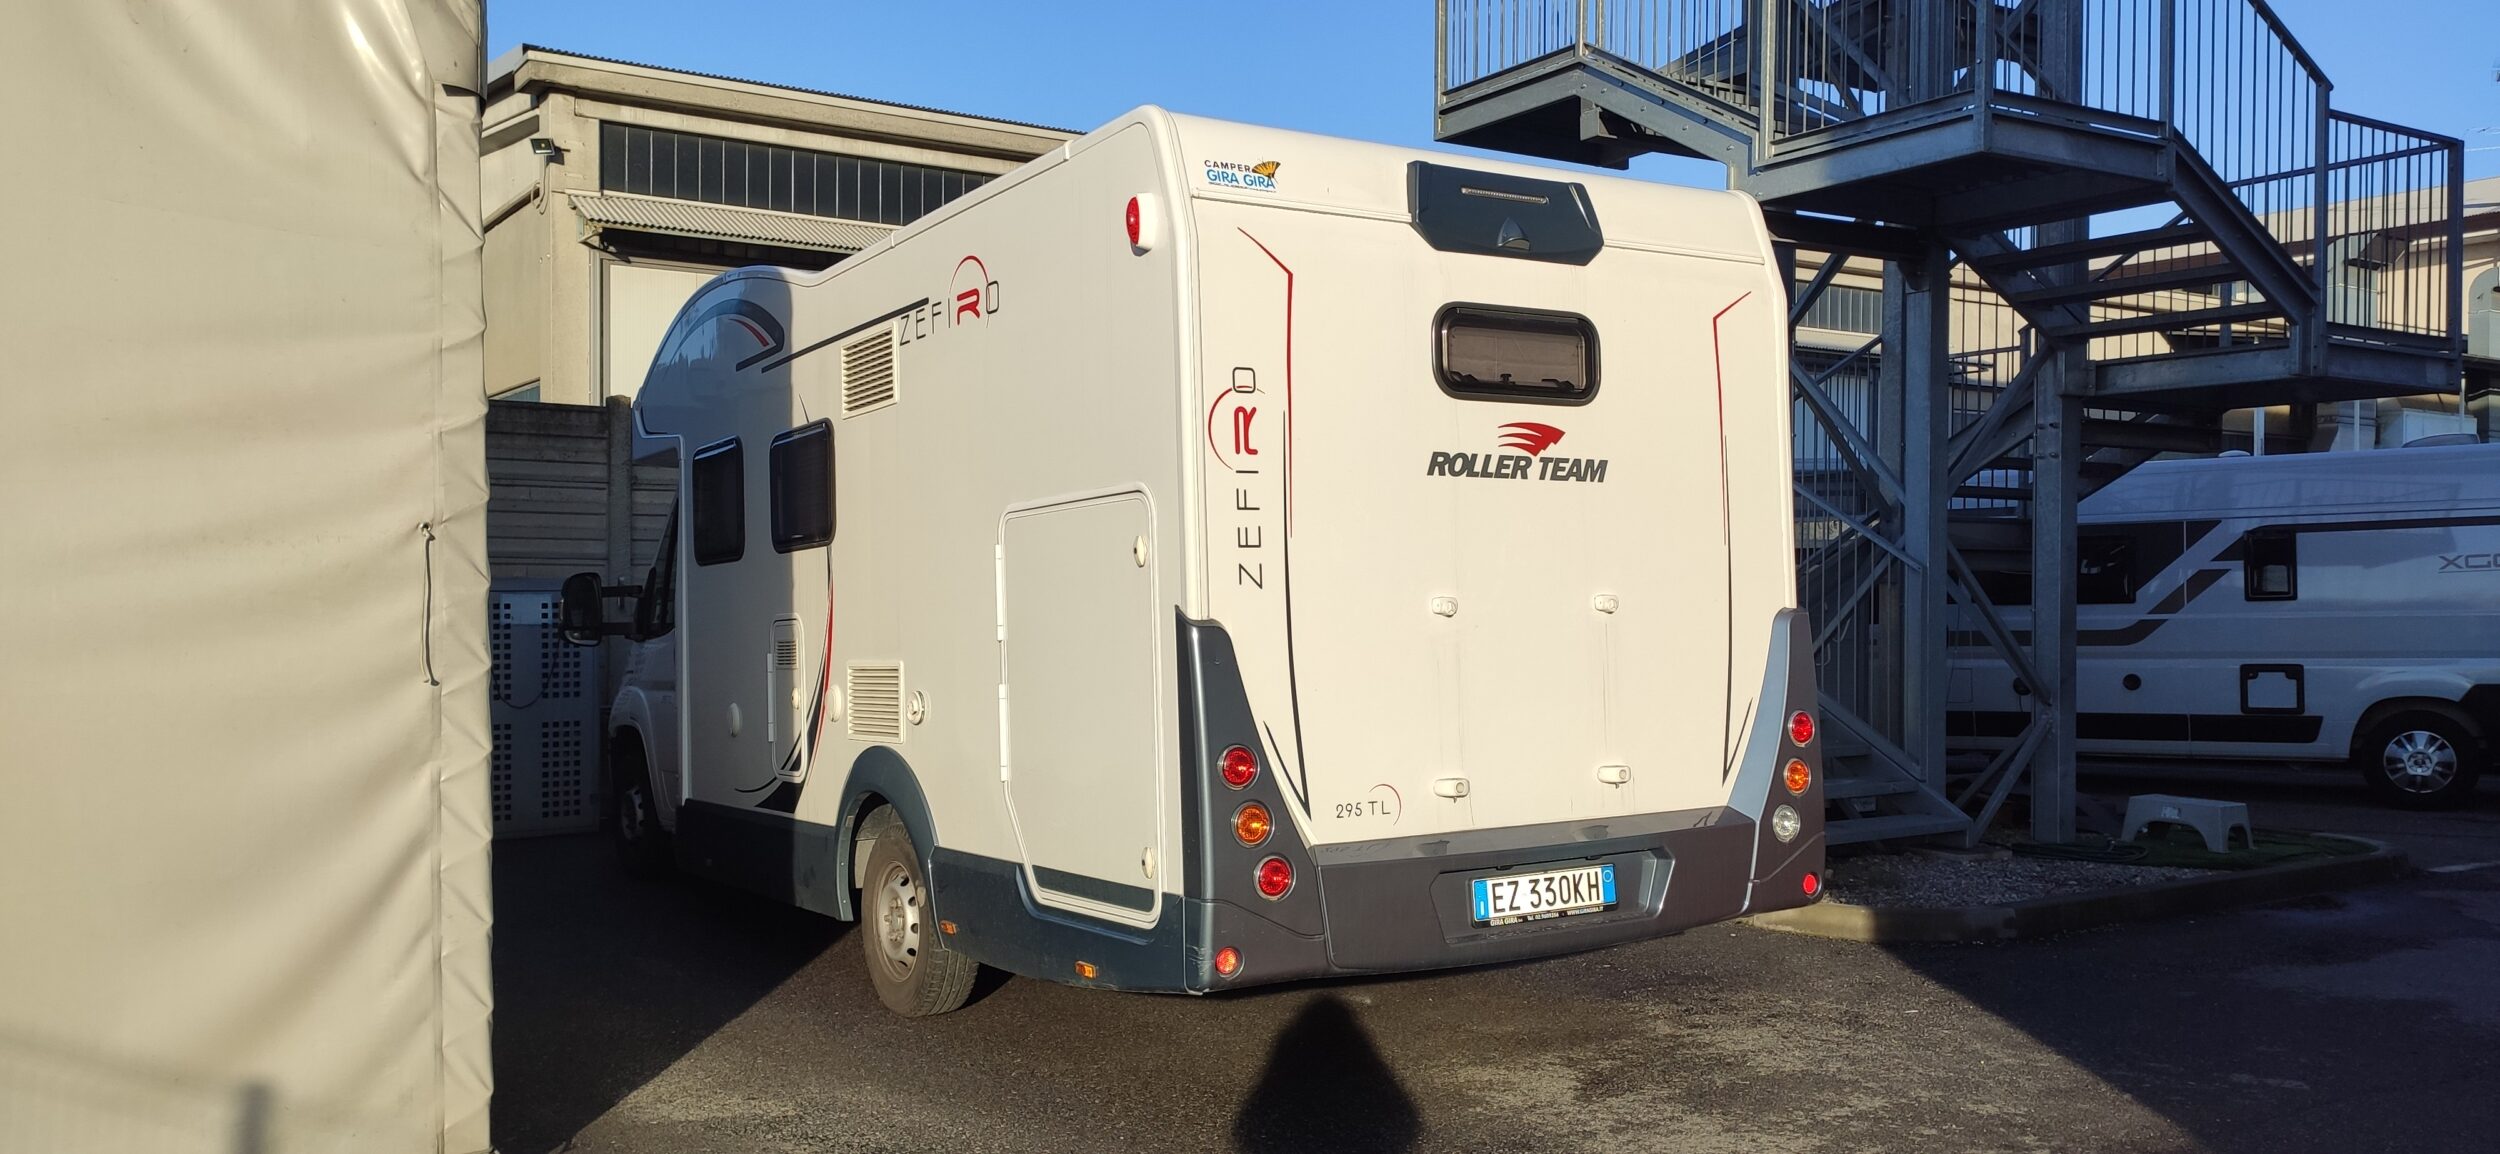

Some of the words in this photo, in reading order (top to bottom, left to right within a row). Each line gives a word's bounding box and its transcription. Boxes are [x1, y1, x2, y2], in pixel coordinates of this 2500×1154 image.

[1204, 160, 1252, 173] CAMPER
[1206, 169, 1239, 185] GIRA
[1243, 173, 1276, 189] GIRA
[899, 280, 1000, 347] ZEFIRO
[1427, 451, 1533, 480] ROLLER
[1539, 456, 1609, 483] TEAM
[1232, 366, 1263, 590] ZEFIRO
[2438, 553, 2500, 570] XG
[1336, 802, 1363, 818] 295
[1367, 800, 1391, 815] TL
[1491, 881, 1521, 914] EZ
[1528, 871, 1601, 909] 330KH
[1490, 917, 1504, 927] GIRA
[1504, 916, 1518, 926] GIRA
